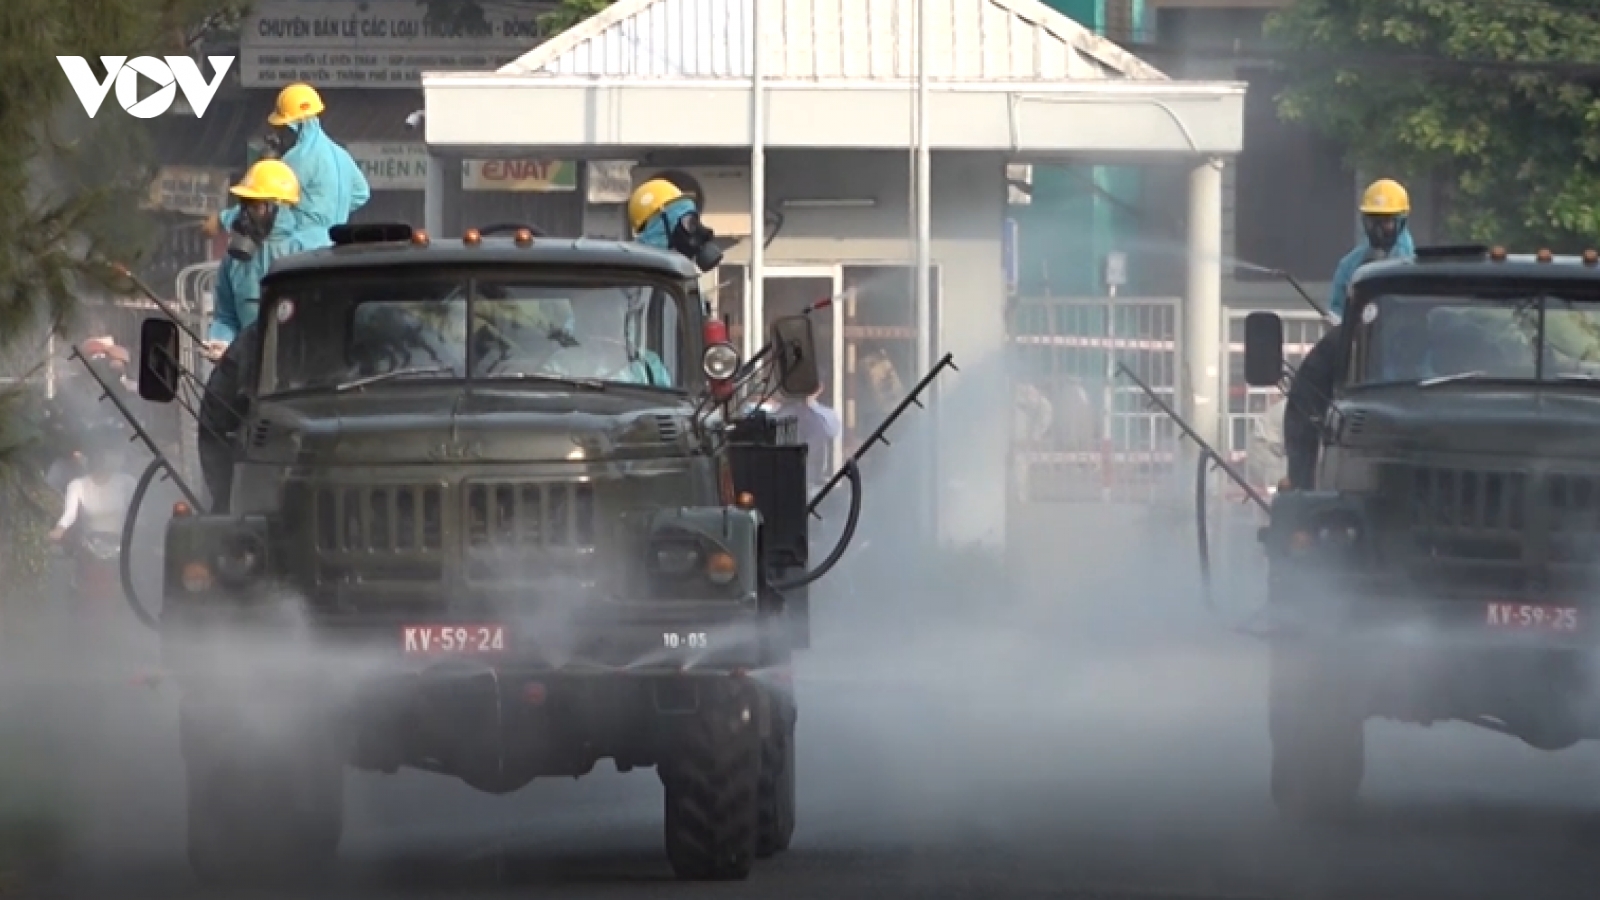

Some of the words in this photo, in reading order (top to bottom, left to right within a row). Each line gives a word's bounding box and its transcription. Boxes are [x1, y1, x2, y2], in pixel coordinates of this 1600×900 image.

[314, 16, 339, 37] BÁN
[361, 15, 387, 37] CÁC
[1487, 603, 1577, 631] KV-59-25
[405, 627, 503, 651] KV-59-24
